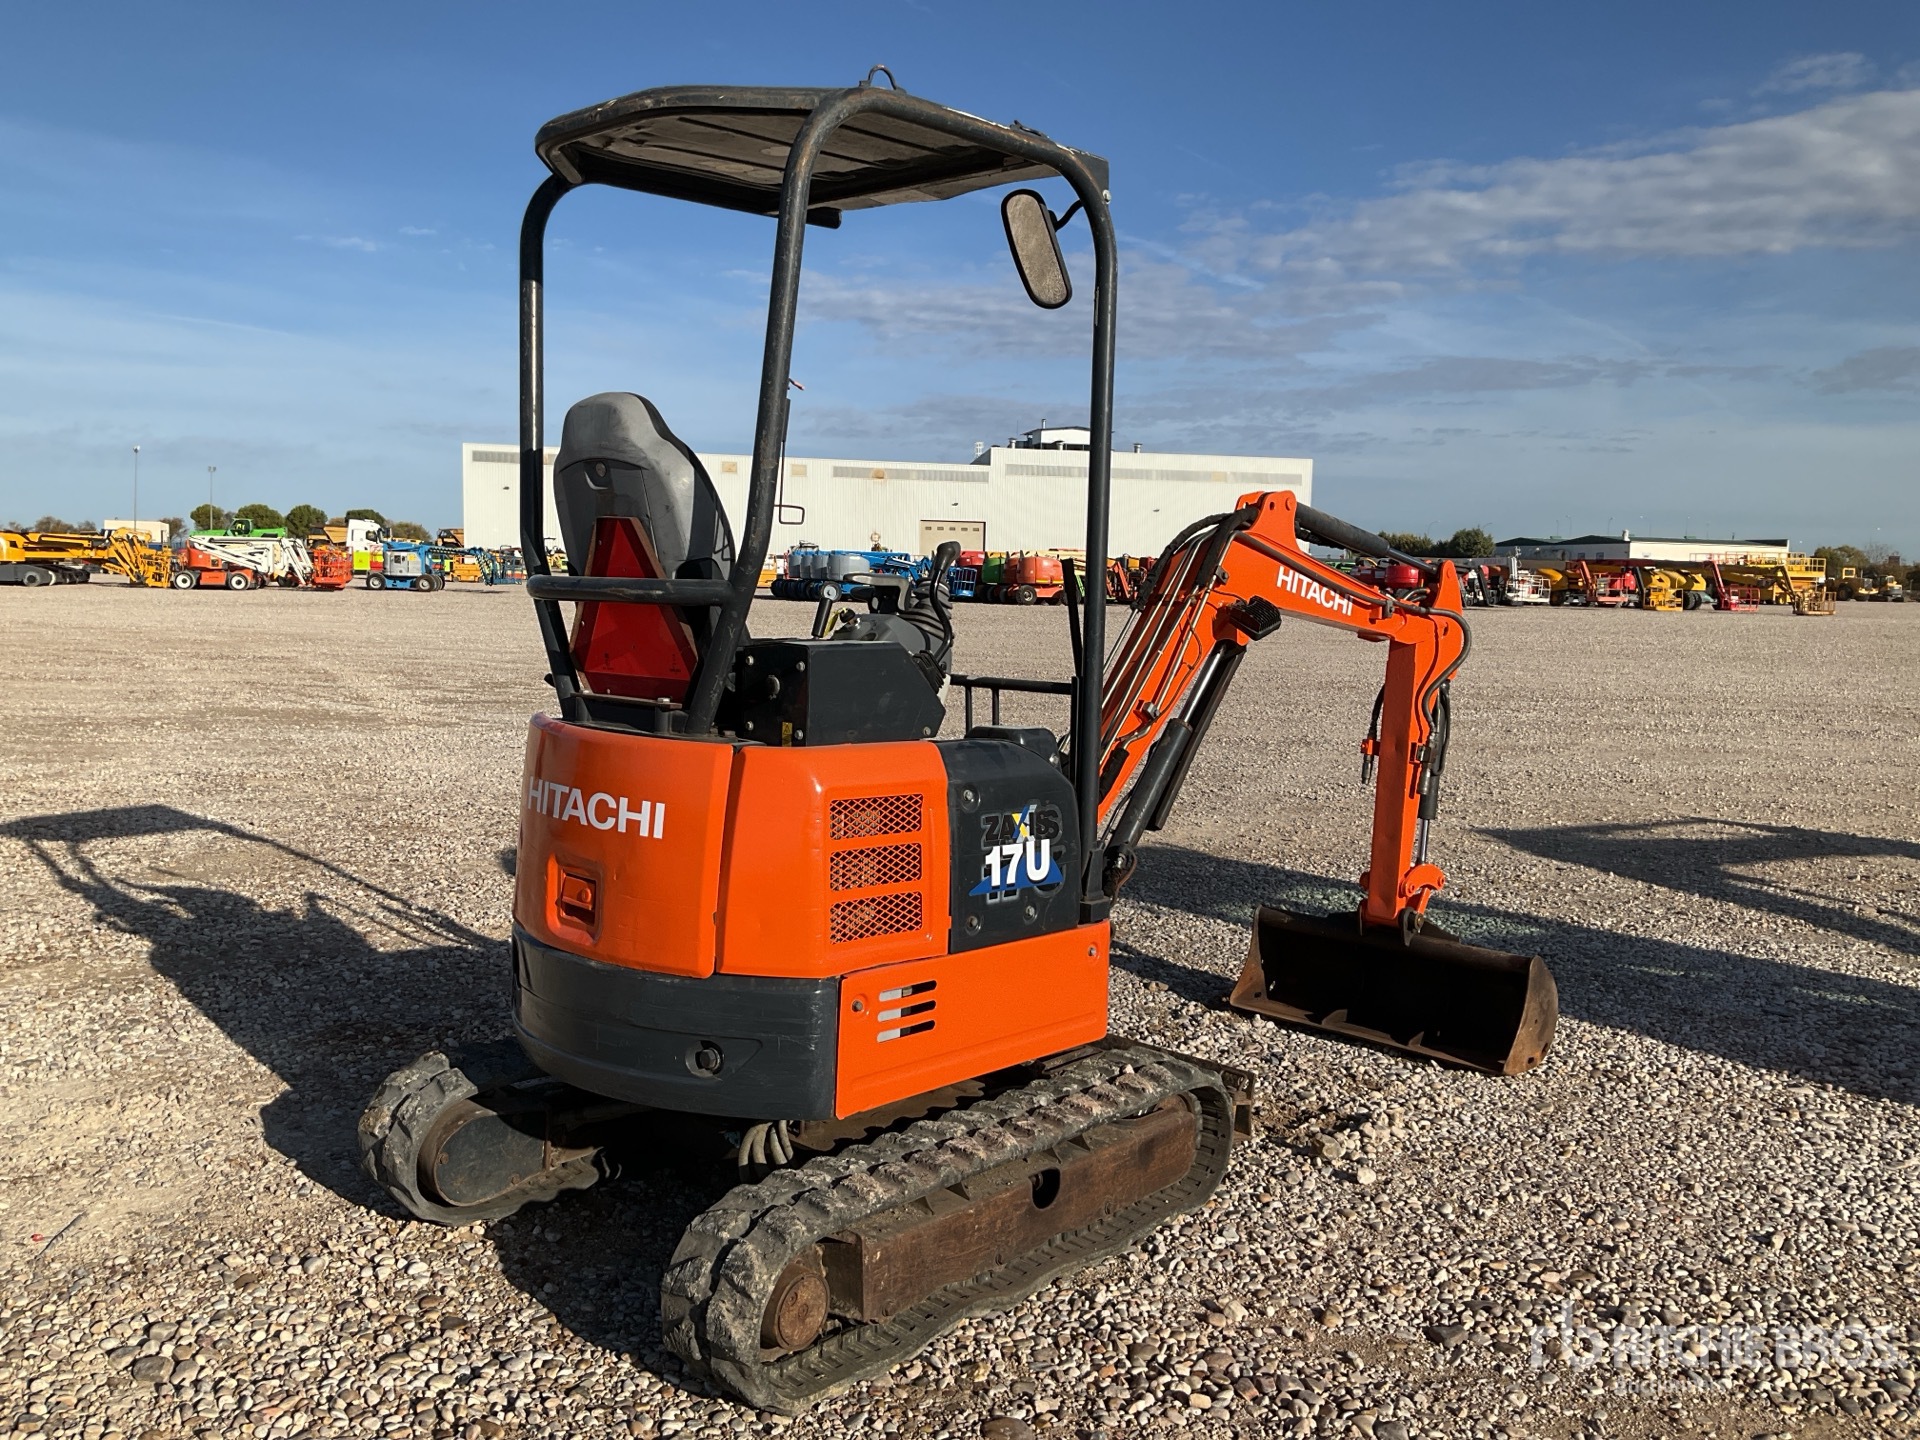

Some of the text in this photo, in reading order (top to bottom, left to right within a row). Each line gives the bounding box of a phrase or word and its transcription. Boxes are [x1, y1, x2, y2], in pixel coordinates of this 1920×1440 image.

[1276, 566, 1354, 617] HITACHI
[527, 776, 666, 840] HITACHI
[985, 838, 1050, 888] 17U
